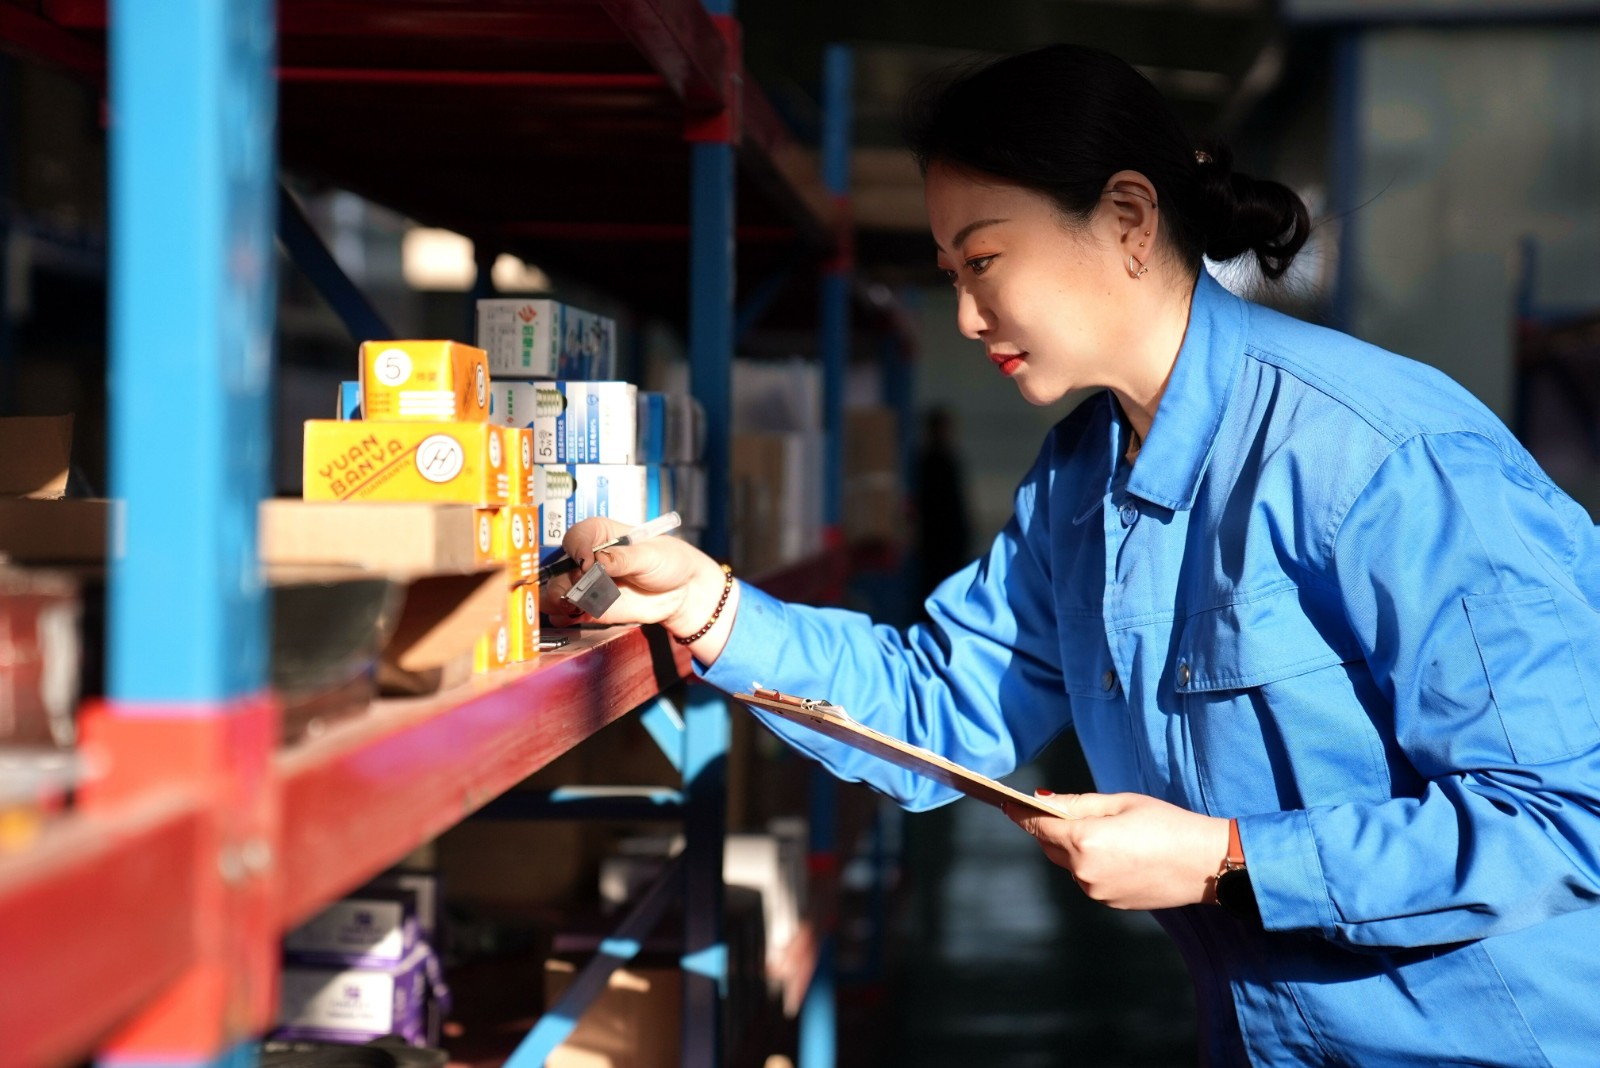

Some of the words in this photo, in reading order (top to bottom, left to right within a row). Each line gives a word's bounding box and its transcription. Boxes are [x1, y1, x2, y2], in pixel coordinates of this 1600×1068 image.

[385, 357, 401, 380] 5
[319, 433, 380, 479] YUAN
[329, 438, 403, 497] BANYA
